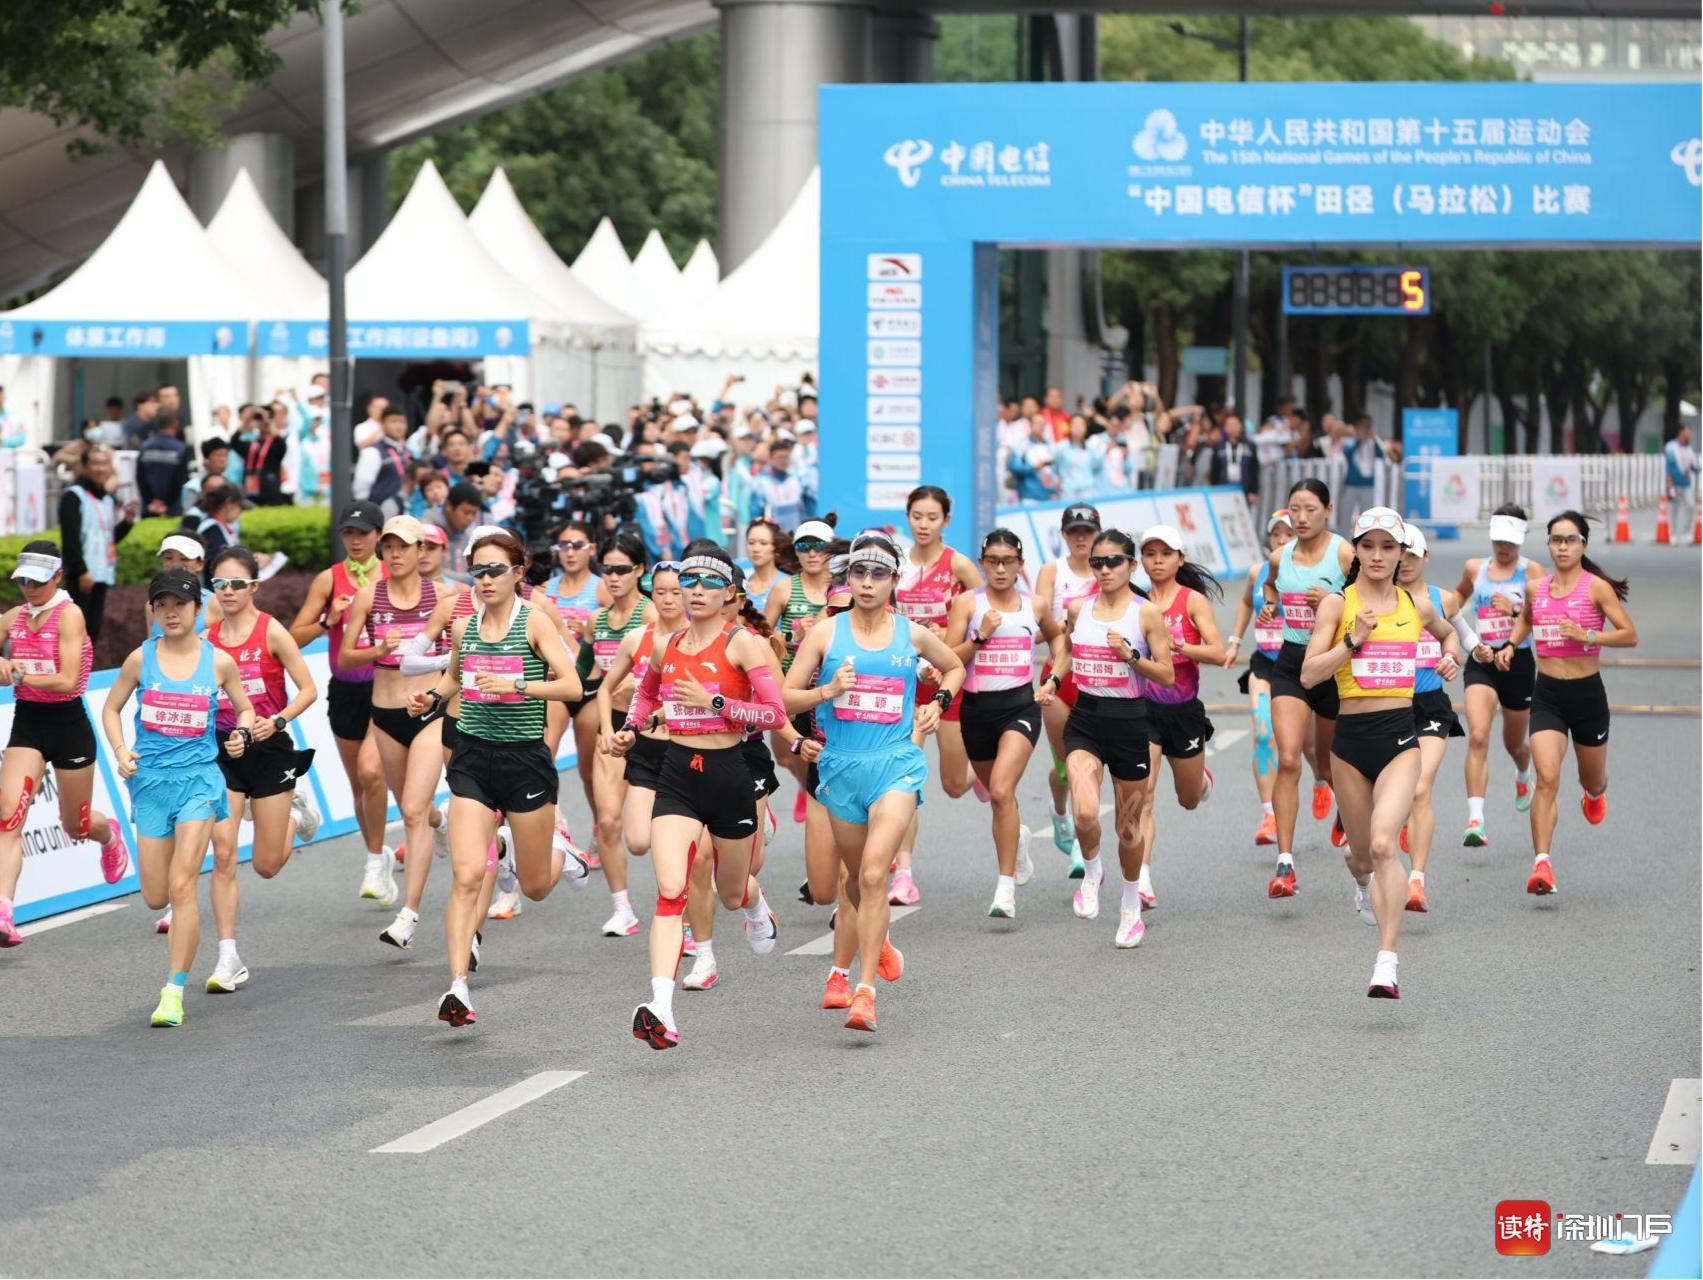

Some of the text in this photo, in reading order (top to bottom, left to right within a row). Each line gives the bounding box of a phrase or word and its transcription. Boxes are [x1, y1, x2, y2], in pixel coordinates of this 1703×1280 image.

[1200, 117, 1591, 146] 中华人民共和国第十五届运动会
[940, 140, 1050, 175] 中国电信
[1202, 150, 1228, 164] The
[1264, 150, 1321, 164] National
[1324, 151, 1371, 164] Games
[1374, 150, 1388, 164] of
[1390, 150, 1413, 164] the
[1415, 150, 1471, 166] People's
[1475, 150, 1532, 166] Republic
[1536, 150, 1550, 164] of
[1553, 150, 1592, 164] China
[1401, 271, 1425, 311] 5
[239, 647, 262, 662] 北京
[891, 654, 912, 667] 河南
[1367, 661, 1403, 674] 李美珍
[155, 709, 193, 725] 徐冰洁
[730, 705, 776, 724] CHINA
